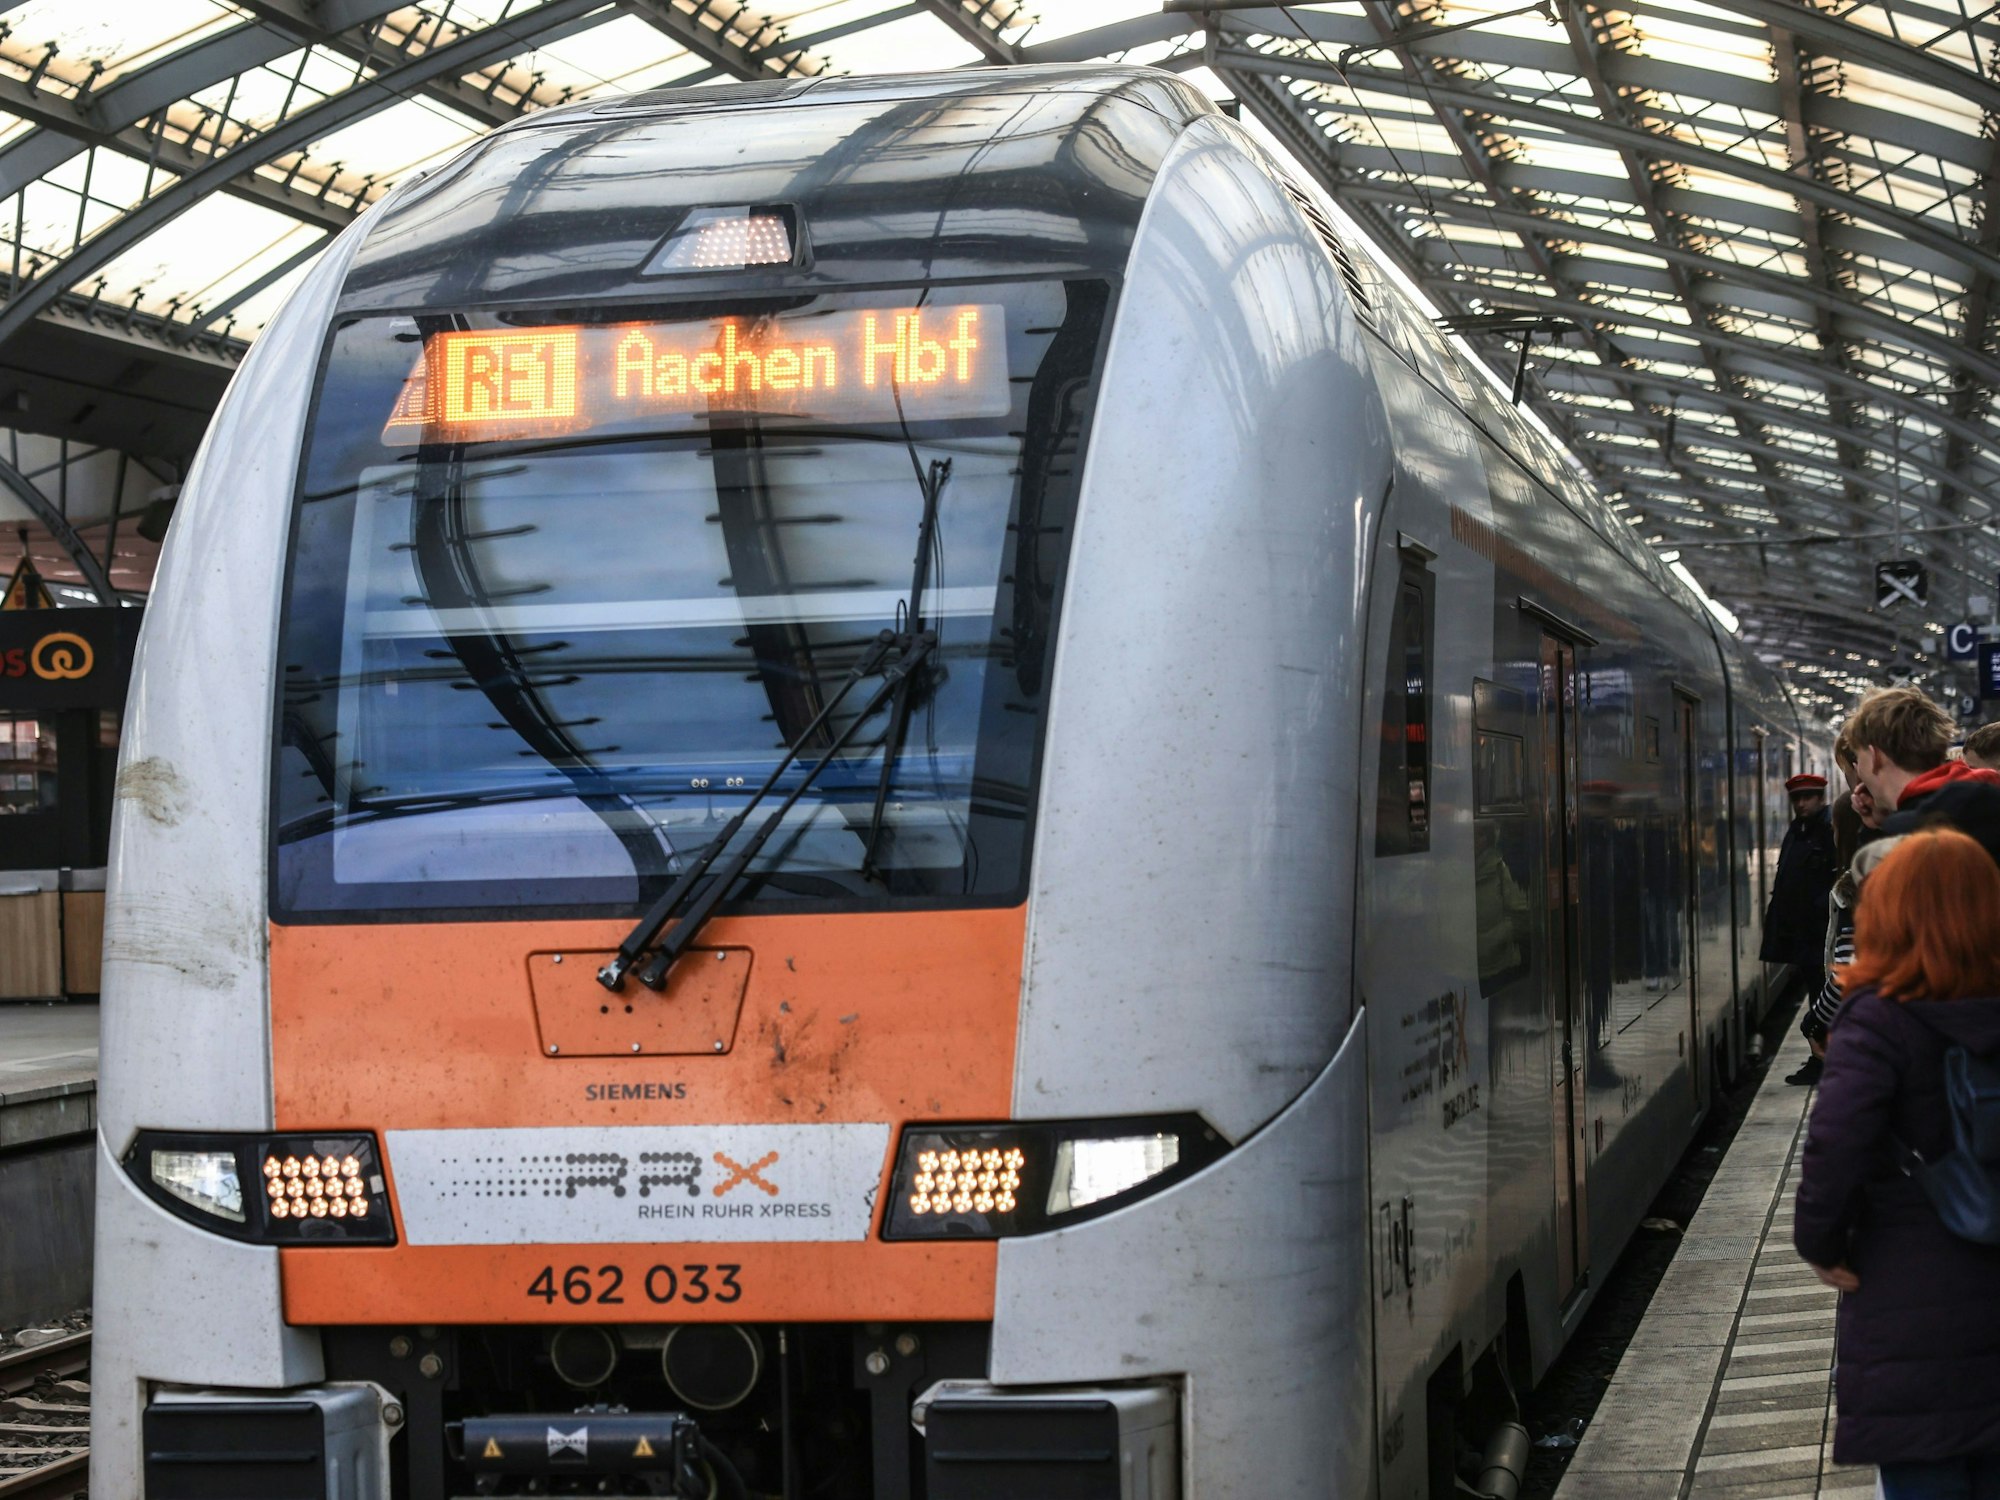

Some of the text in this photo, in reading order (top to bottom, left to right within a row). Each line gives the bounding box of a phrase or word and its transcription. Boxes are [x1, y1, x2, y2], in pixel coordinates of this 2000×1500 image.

[461, 307, 978, 412] RE1 Aachen Hbf
[1951, 623, 1974, 654] C
[585, 1082, 687, 1101] SIEMENS
[565, 1150, 780, 1199] RRX
[638, 1203, 832, 1220] RHEIN RUHR XPRESS
[527, 1264, 742, 1305] 462 033
